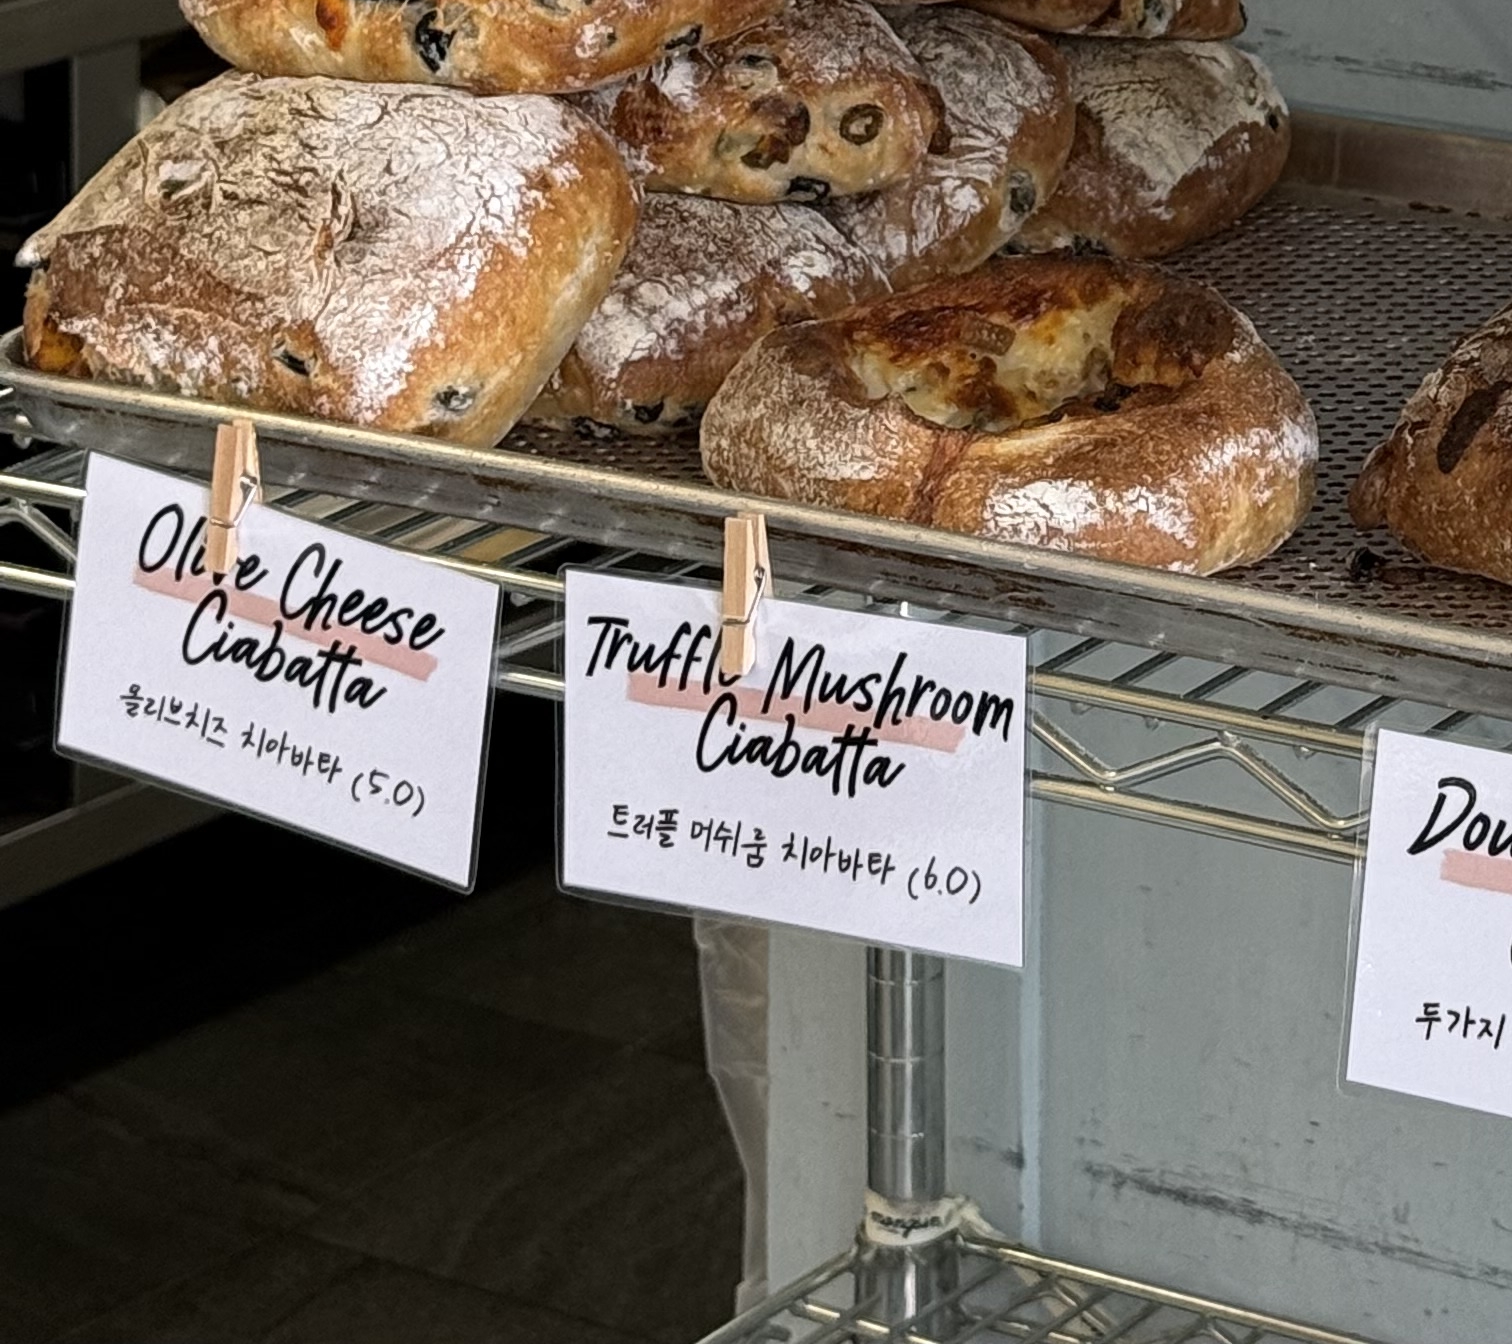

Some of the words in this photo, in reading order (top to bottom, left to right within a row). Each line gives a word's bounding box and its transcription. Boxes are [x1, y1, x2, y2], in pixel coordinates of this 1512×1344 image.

[279, 543, 445, 651] Cheese
[182, 589, 387, 714] Ciabatta
[586, 615, 742, 695] Truffl
[761, 637, 1014, 743] Mushroom
[120, 683, 229, 749] 올리브치즈
[241, 722, 343, 784] 치아바타
[350, 768, 426, 817] (5.0)
[696, 692, 906, 798] Ciabatta
[607, 805, 679, 848] 트러플
[691, 819, 768, 869] 머쉬룸
[782, 832, 896, 886] 치아바타
[907, 856, 982, 905] (6.0)
[1415, 1001, 1506, 1050] 두가지
